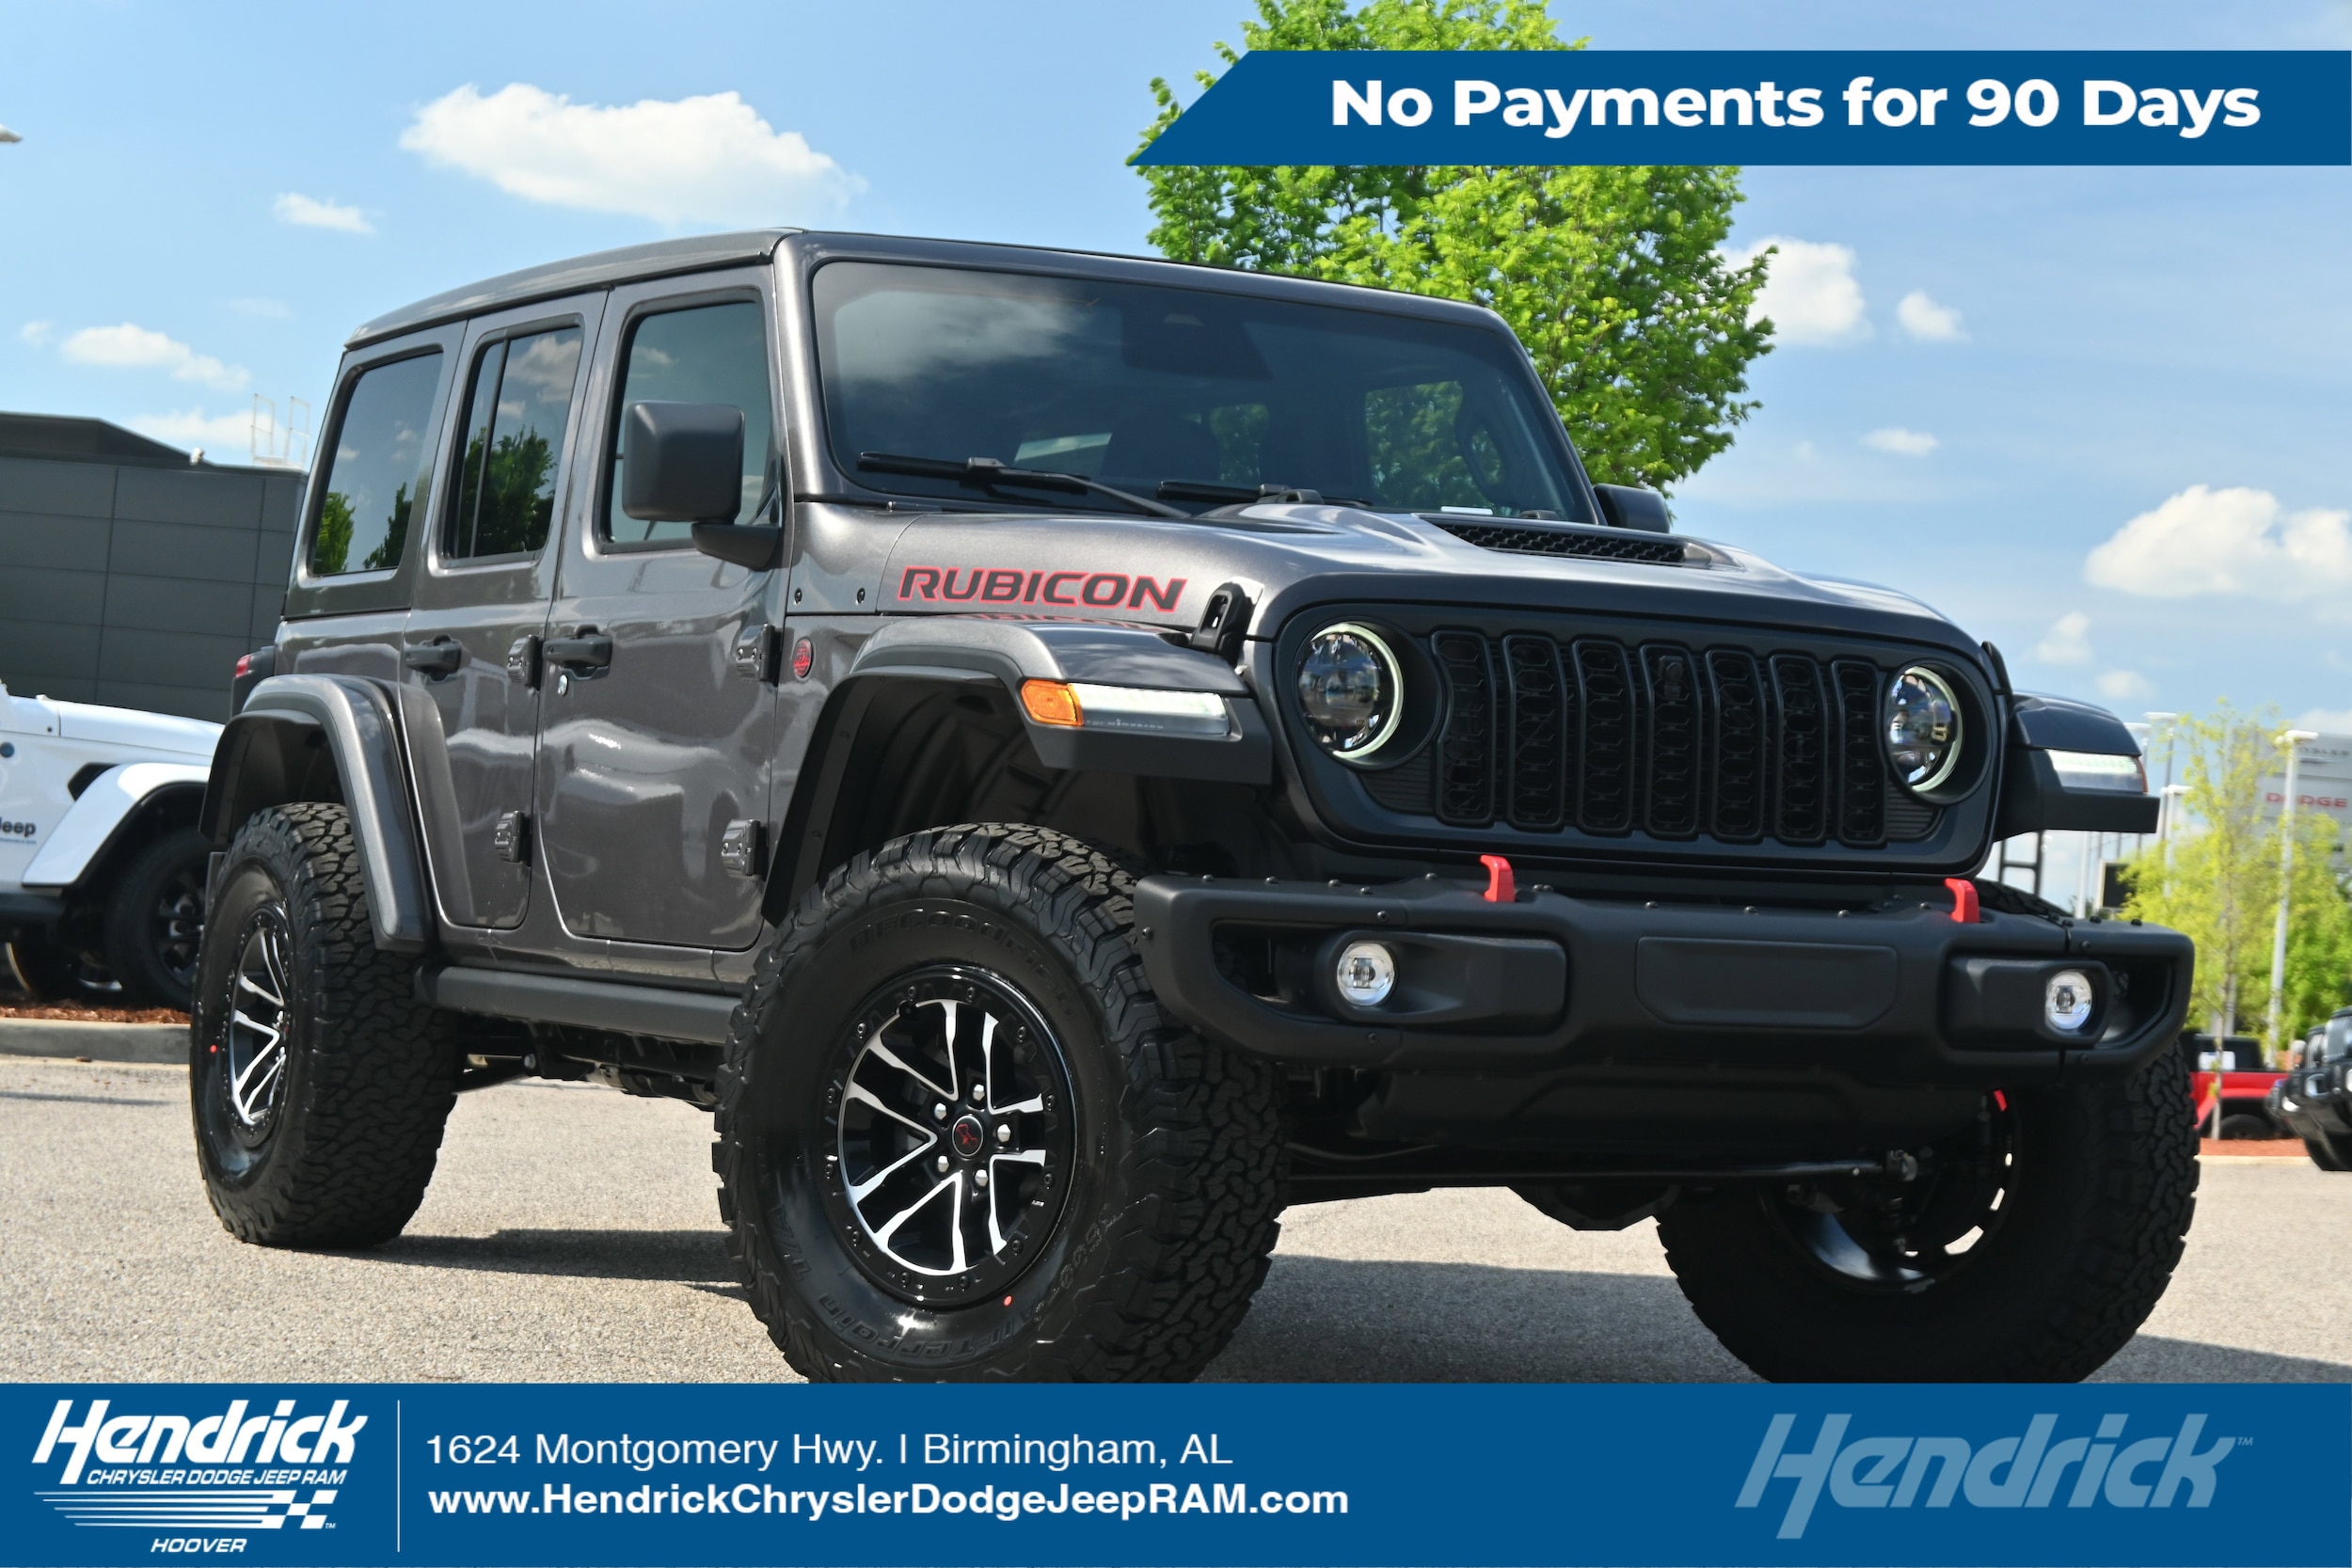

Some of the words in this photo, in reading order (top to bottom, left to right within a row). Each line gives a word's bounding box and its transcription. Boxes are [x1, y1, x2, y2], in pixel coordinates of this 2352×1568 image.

[897, 566, 1188, 612] RUBICON
[2265, 793, 2348, 807] DDGE
[0, 816, 37, 837] eep
